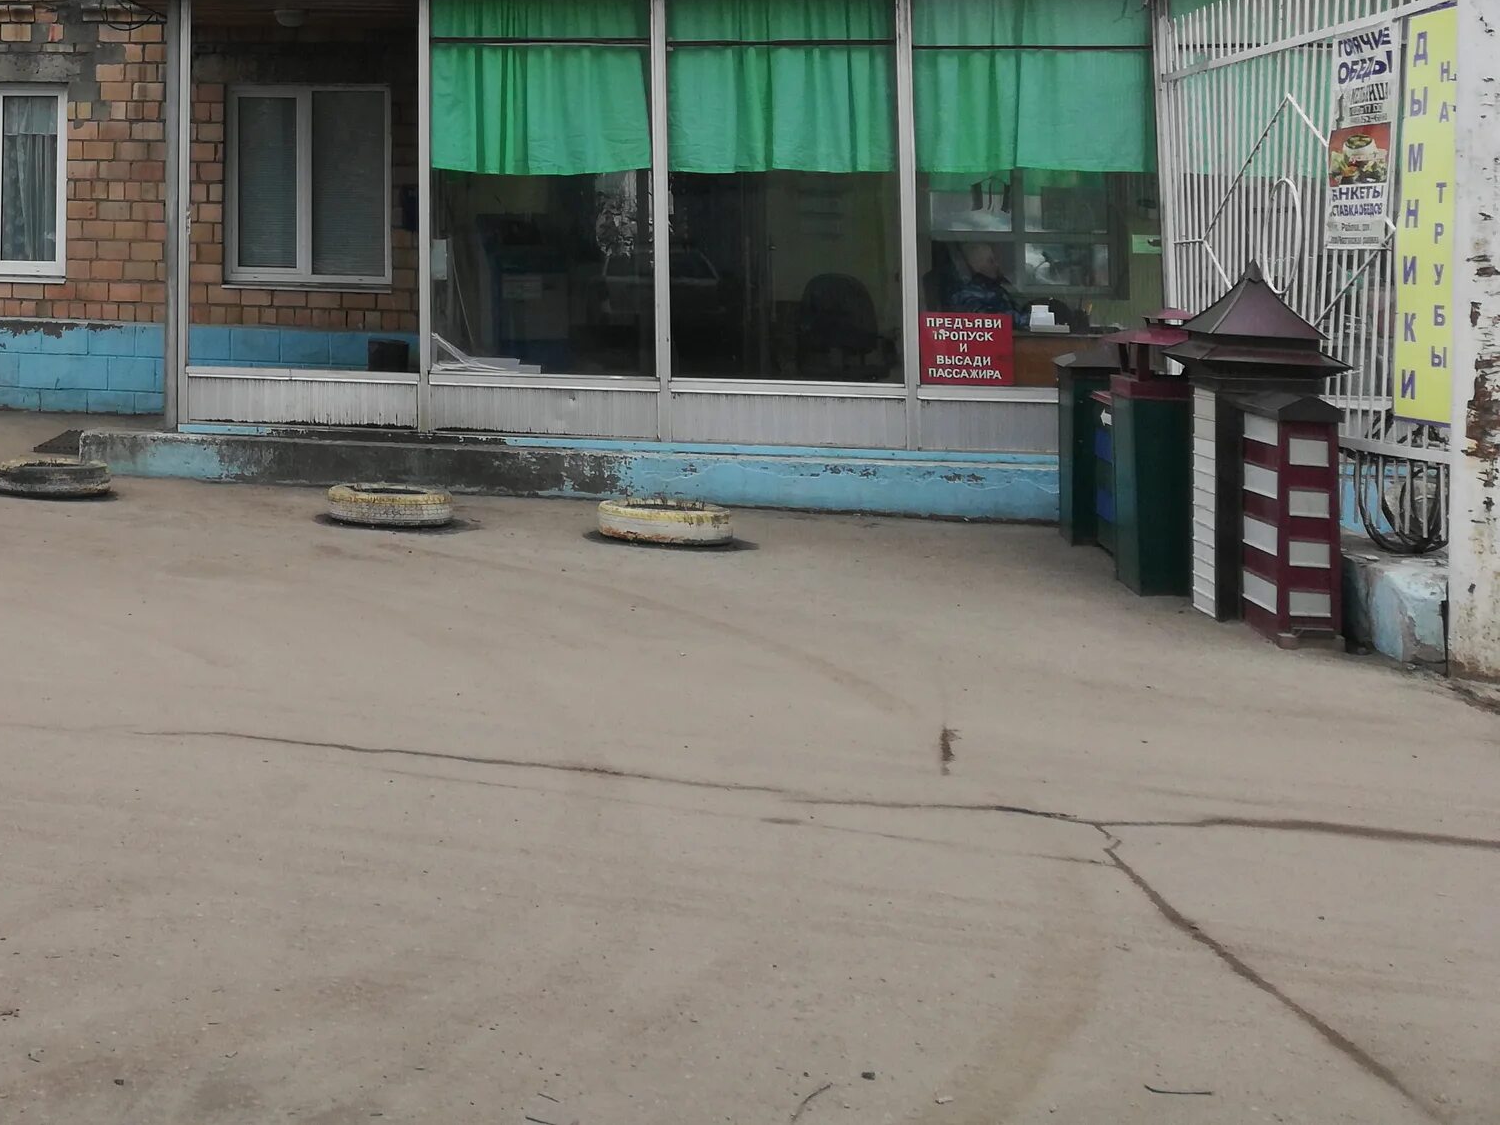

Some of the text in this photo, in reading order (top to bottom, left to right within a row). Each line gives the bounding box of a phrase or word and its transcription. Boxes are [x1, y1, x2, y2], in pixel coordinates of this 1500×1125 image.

[926, 317, 1002, 329] ПРЕДЪЯВИ
[933, 331, 994, 341] ПРОПУСК
[959, 342, 968, 353] И
[936, 355, 991, 367] ВЫСАДИ
[928, 368, 1002, 380] ПАССАЖИРА
